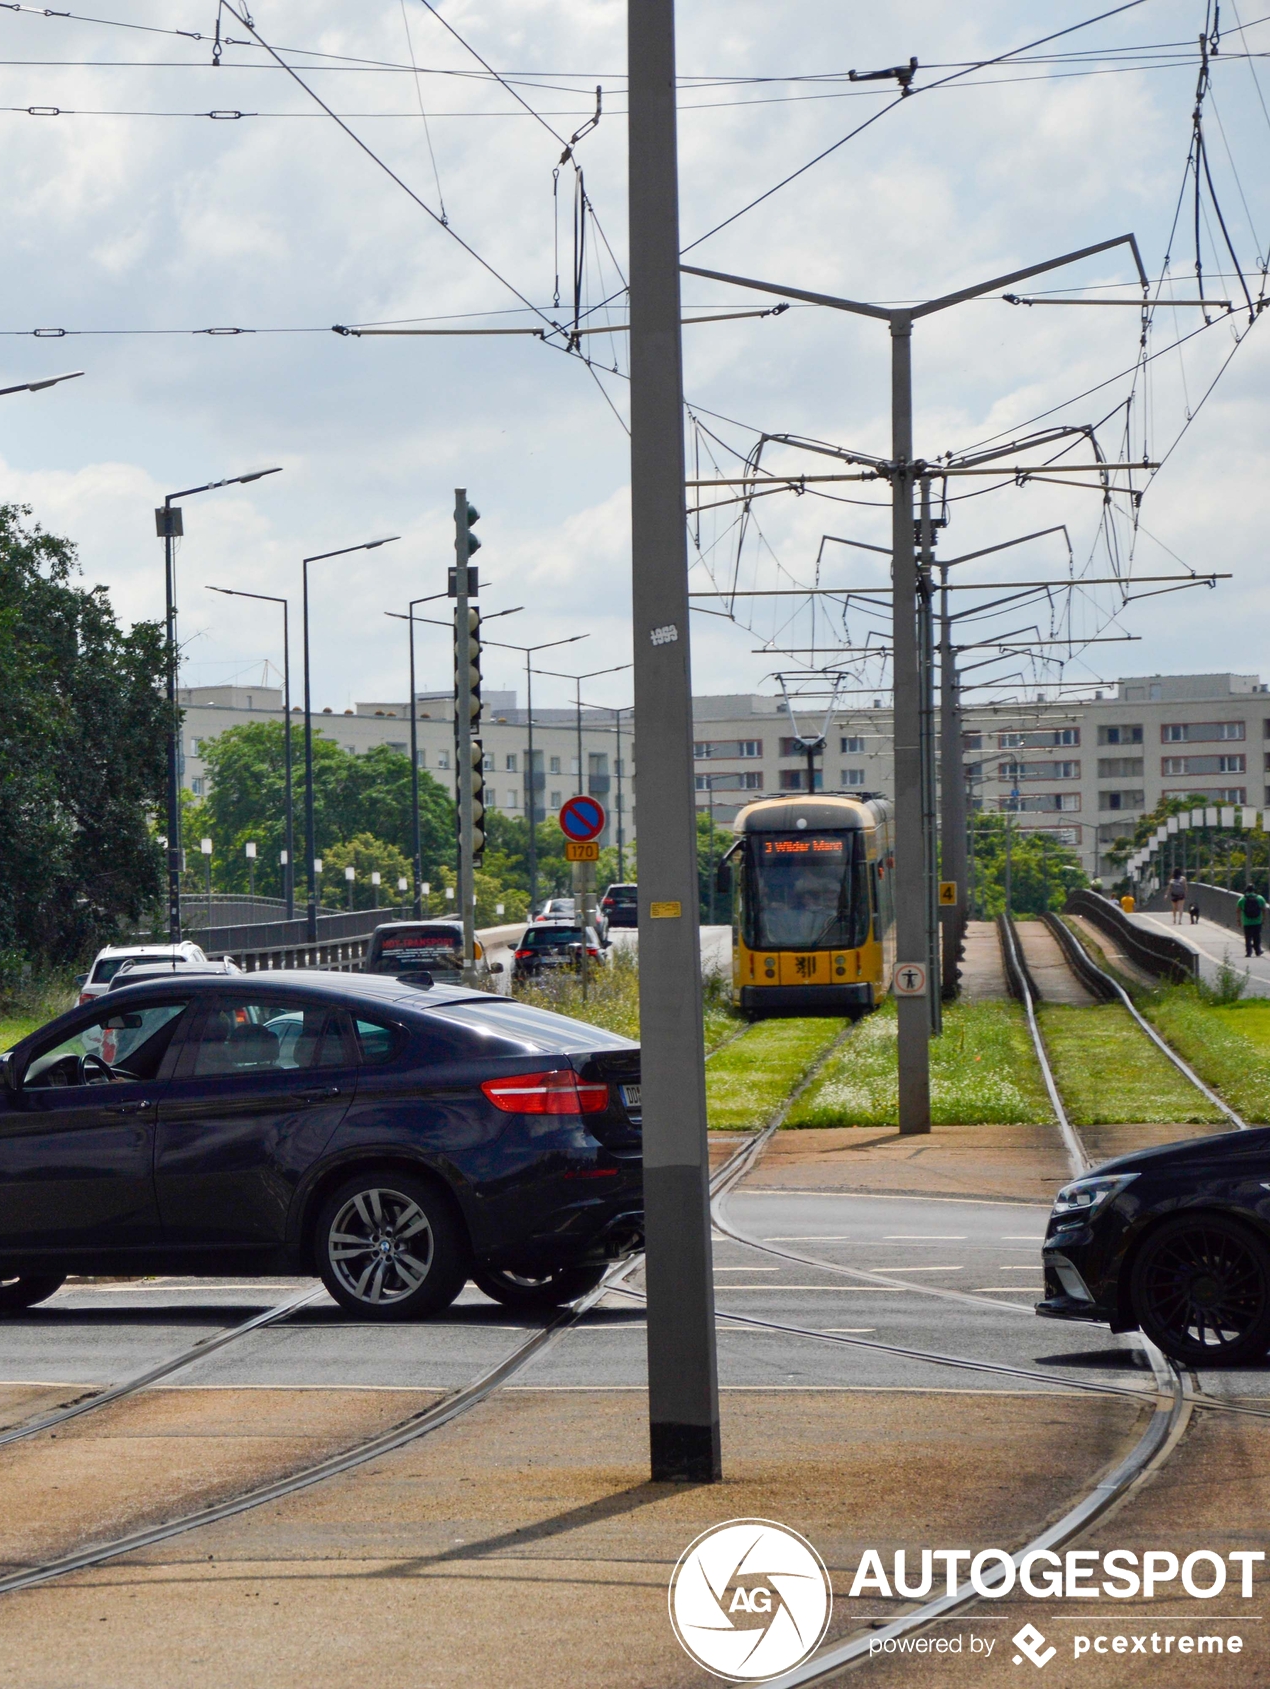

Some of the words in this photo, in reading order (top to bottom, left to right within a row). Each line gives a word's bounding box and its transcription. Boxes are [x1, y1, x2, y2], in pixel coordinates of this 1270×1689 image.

[572, 845, 593, 858] 170
[765, 842, 772, 853] 3
[775, 841, 810, 853] Wilder
[942, 886, 953, 901] 4
